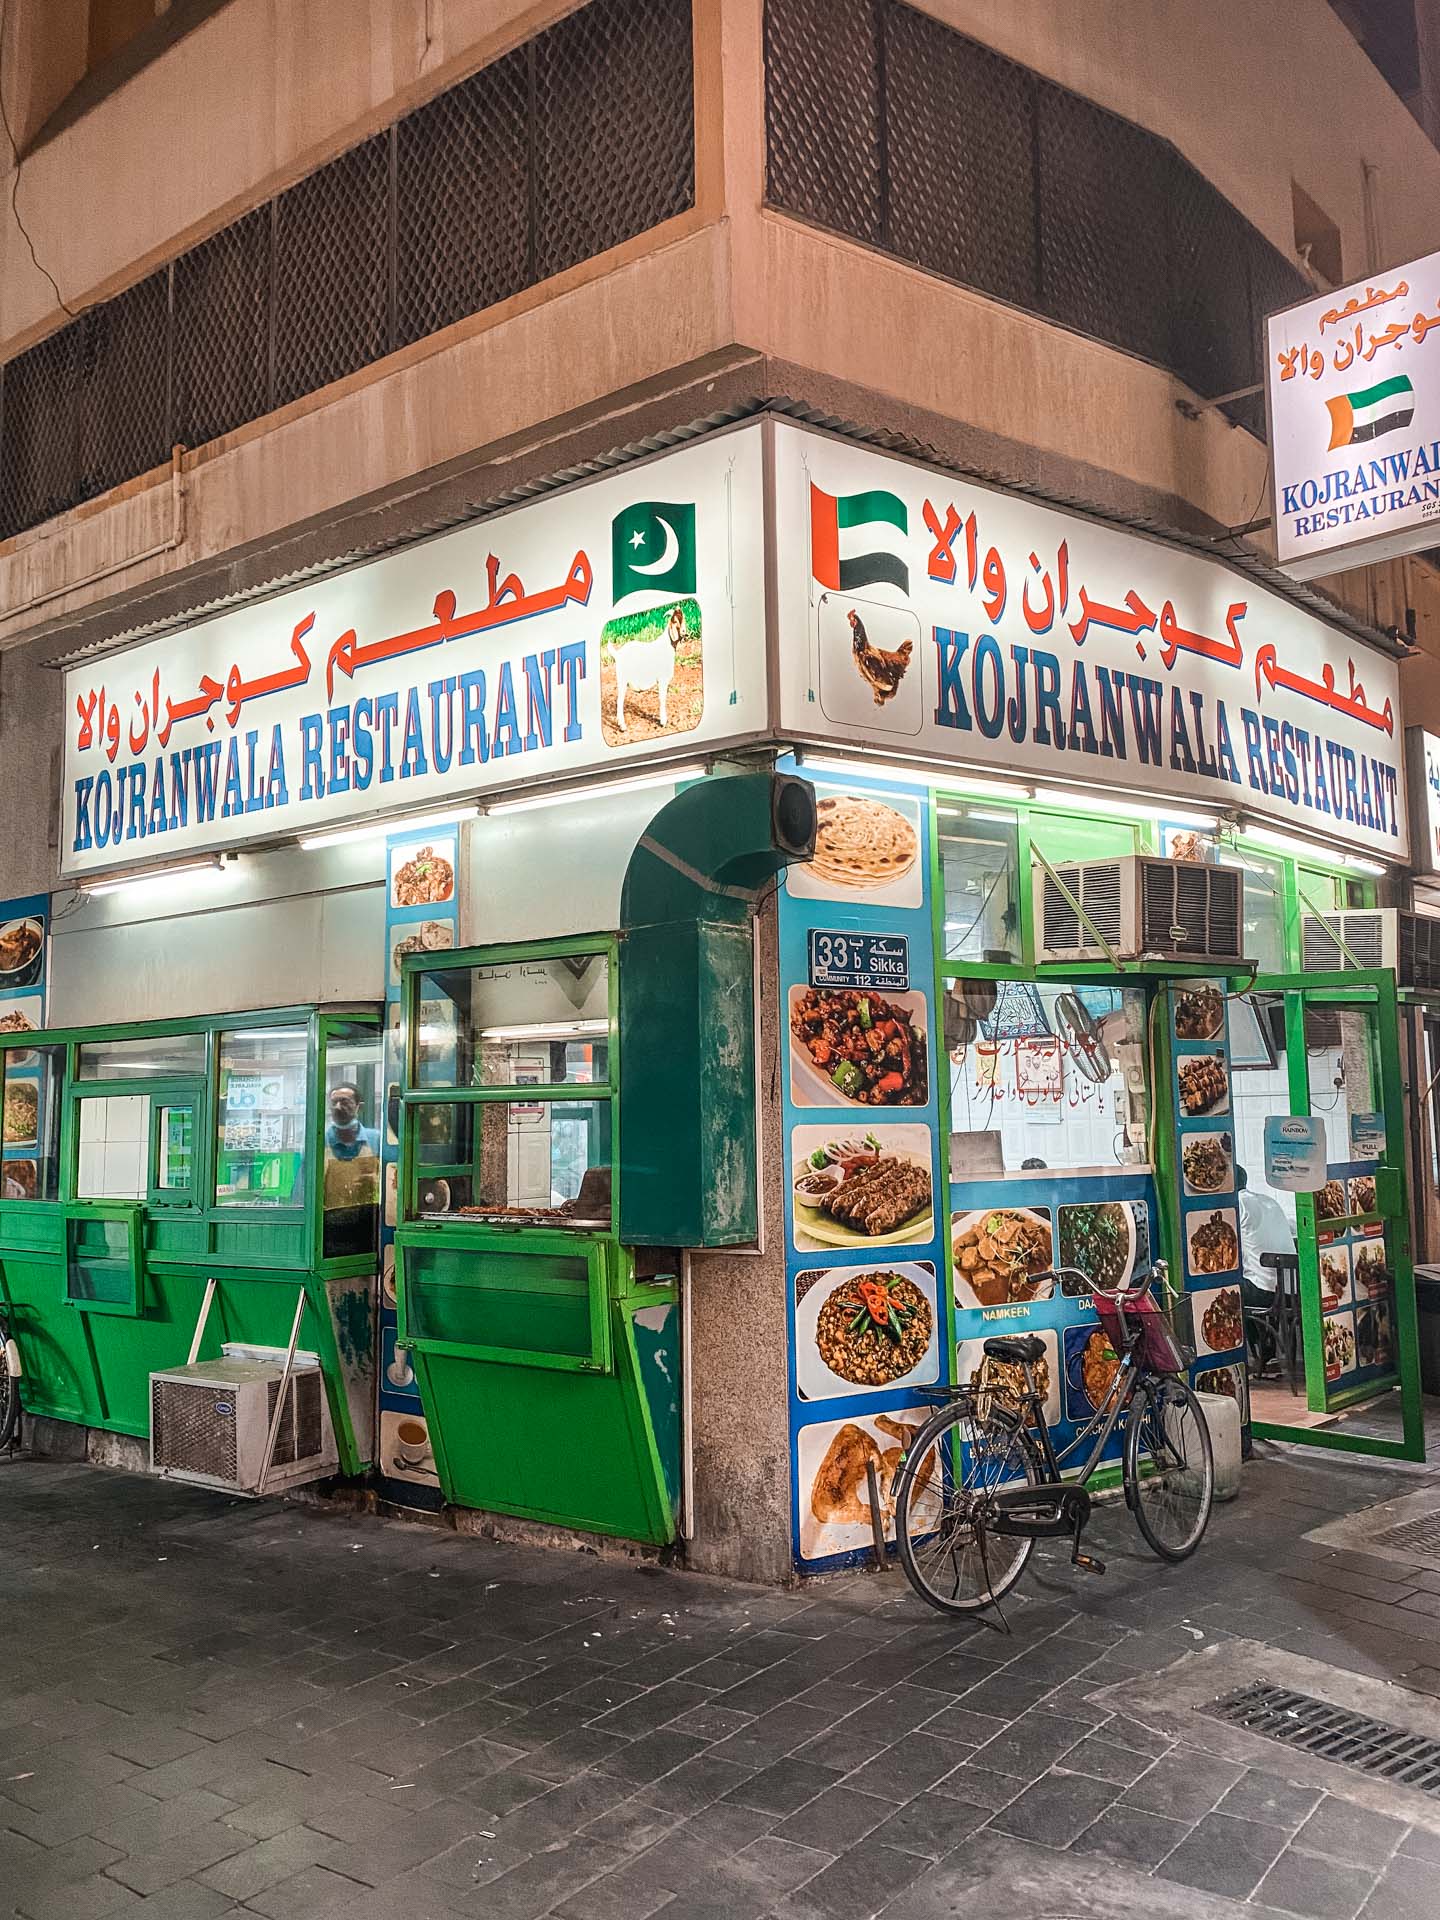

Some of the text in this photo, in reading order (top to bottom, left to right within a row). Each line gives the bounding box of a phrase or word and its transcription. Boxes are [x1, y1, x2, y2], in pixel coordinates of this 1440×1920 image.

[1319, 281, 1409, 335] مطعم
[1333, 297, 1440, 371] وجران
[1282, 441, 1440, 515] KOJRANWAL
[1294, 478, 1440, 537] RESTAURAN
[326, 548, 594, 704] مطعم
[1255, 642, 1394, 737] مطعم
[73, 640, 587, 853] KOJRANWALA RESTAURANT
[931, 625, 1398, 837] KOJRANWALA RESTAURANT
[818, 936, 848, 968] 33
[849, 937, 904, 957] سكة ب
[853, 951, 904, 974] b Sikka
[819, 975, 850, 984] COMMUNITY
[854, 975, 871, 986] 112
[982, 1306, 1031, 1321] NAMKEEN
[1078, 1299, 1098, 1311] DAA
[1118, 1414, 1151, 1431] KHI
